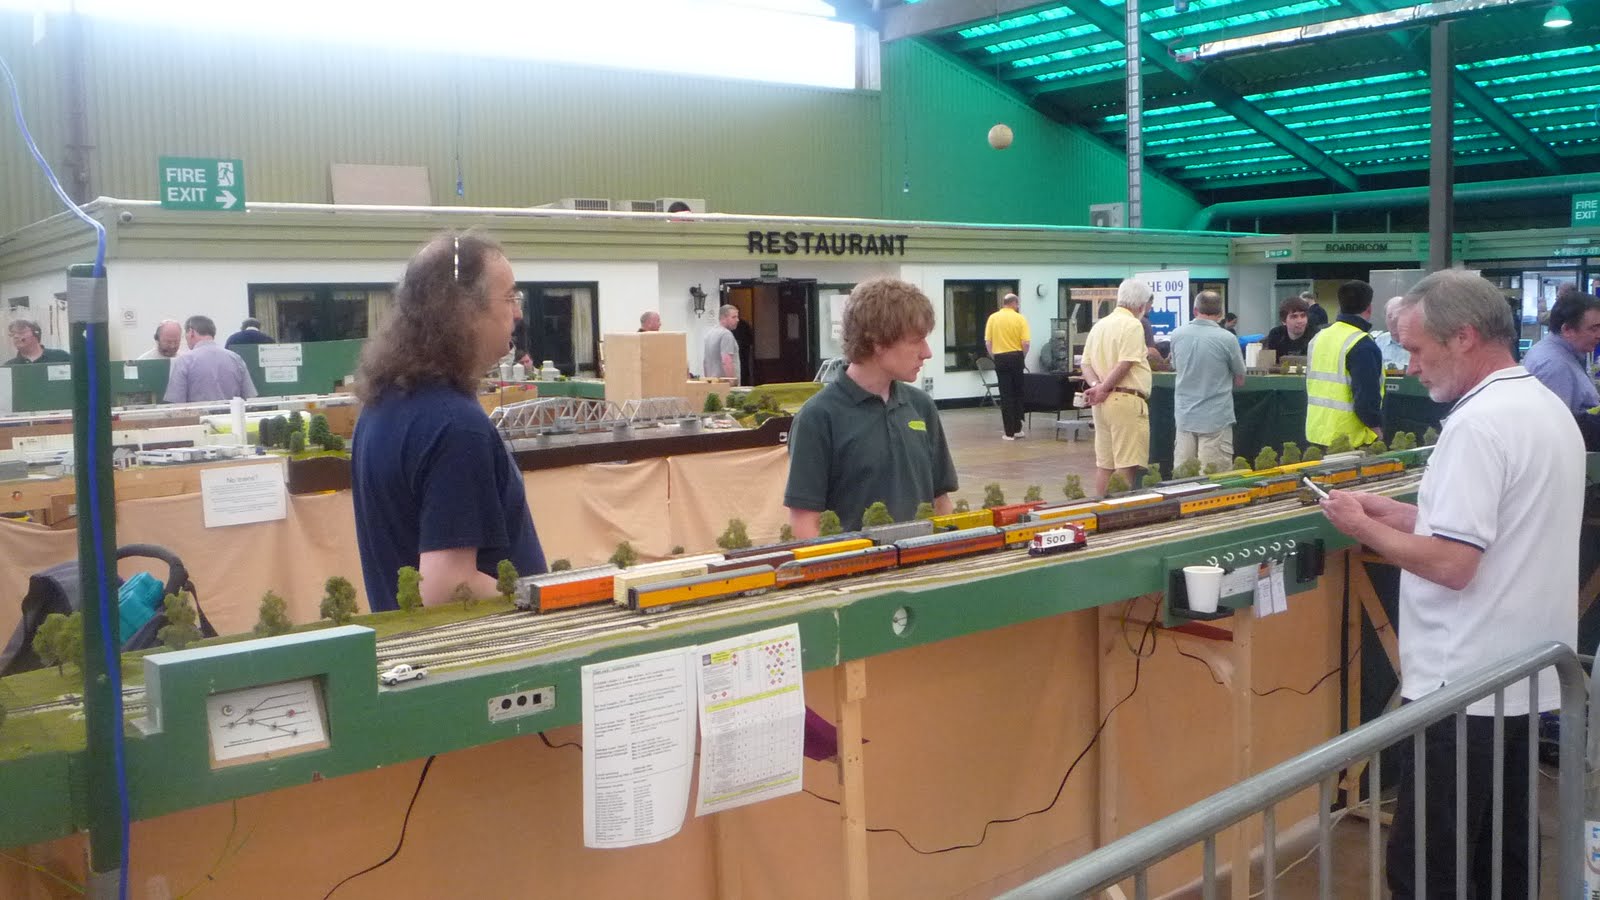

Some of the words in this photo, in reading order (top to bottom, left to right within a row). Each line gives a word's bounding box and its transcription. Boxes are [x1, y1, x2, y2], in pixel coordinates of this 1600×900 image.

[166, 167, 207, 183] FIRE
[167, 187, 207, 202] EXIT
[1575, 200, 1598, 210] FIRE
[1575, 210, 1597, 220] EXIT
[747, 231, 908, 256] RESTAURANT
[1165, 280, 1184, 292] 009
[1046, 534, 1066, 545] SOO
